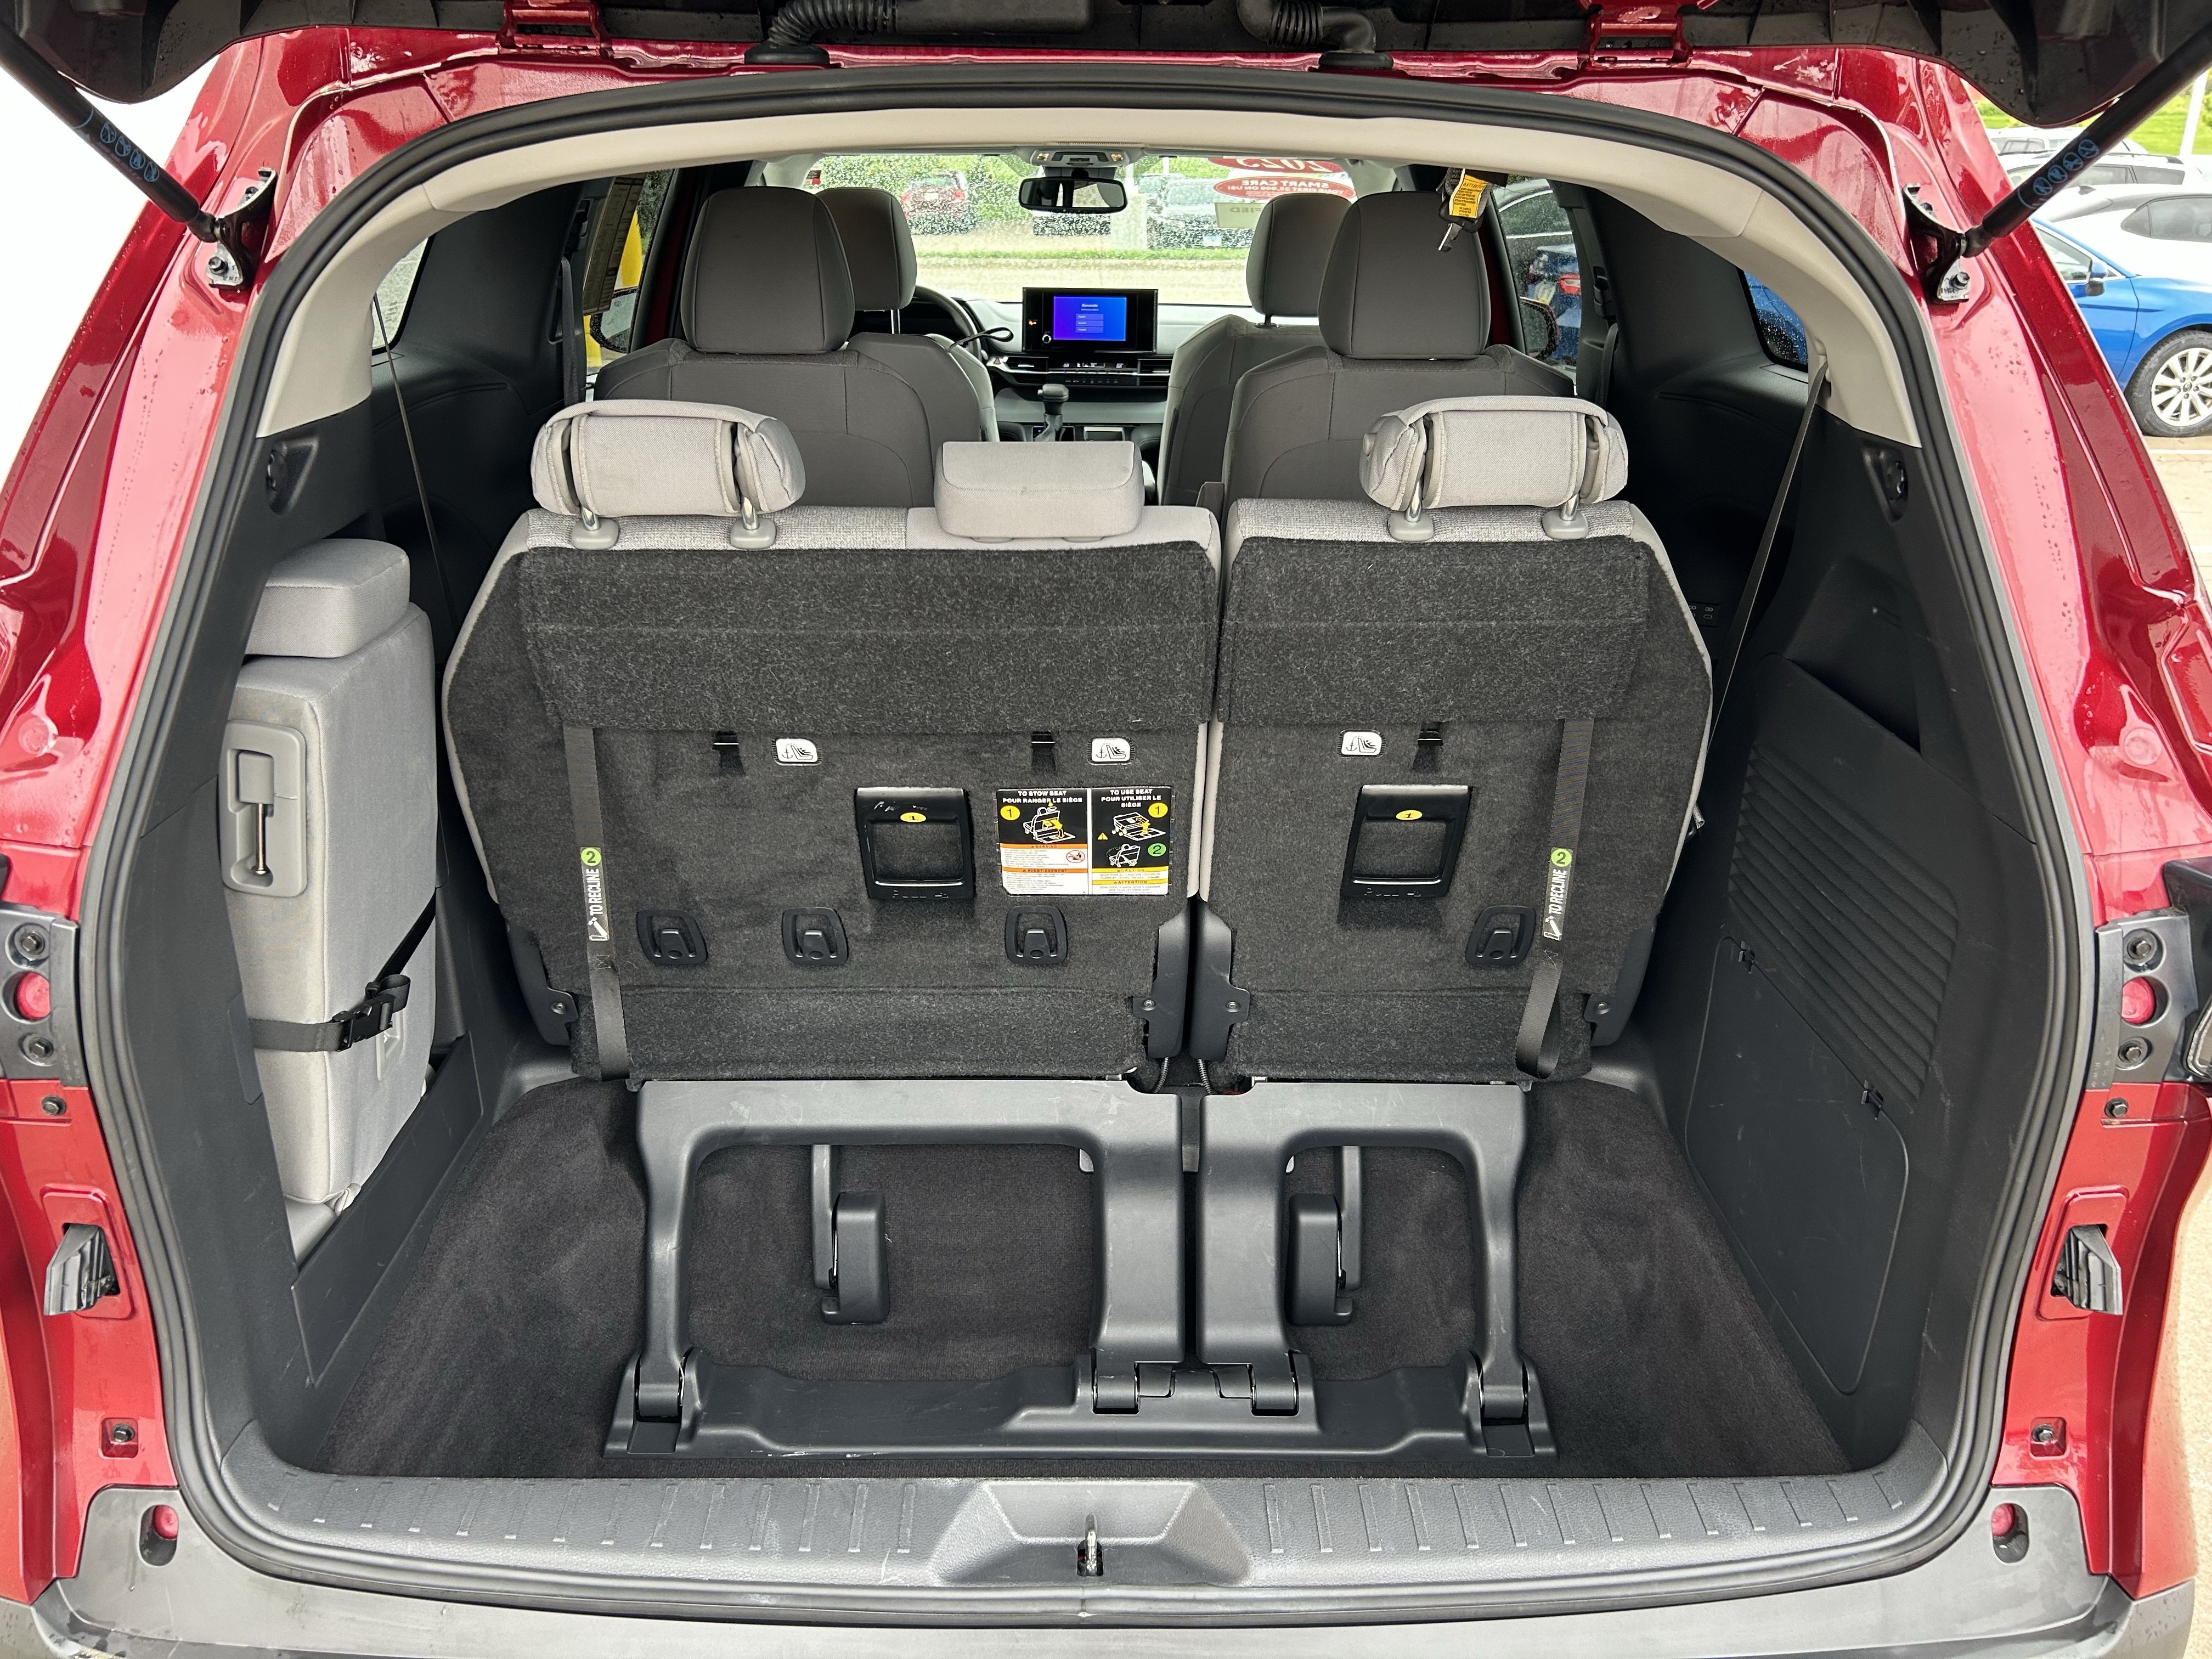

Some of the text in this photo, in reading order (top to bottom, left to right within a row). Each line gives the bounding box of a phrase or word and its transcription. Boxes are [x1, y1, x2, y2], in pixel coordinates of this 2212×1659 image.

[586, 850, 596, 864] 2
[1153, 845, 1163, 855] 2
[1556, 851, 1567, 865] 2
[585, 868, 603, 916] TO RECLINE
[1548, 868, 1567, 915] TO RECLINE
